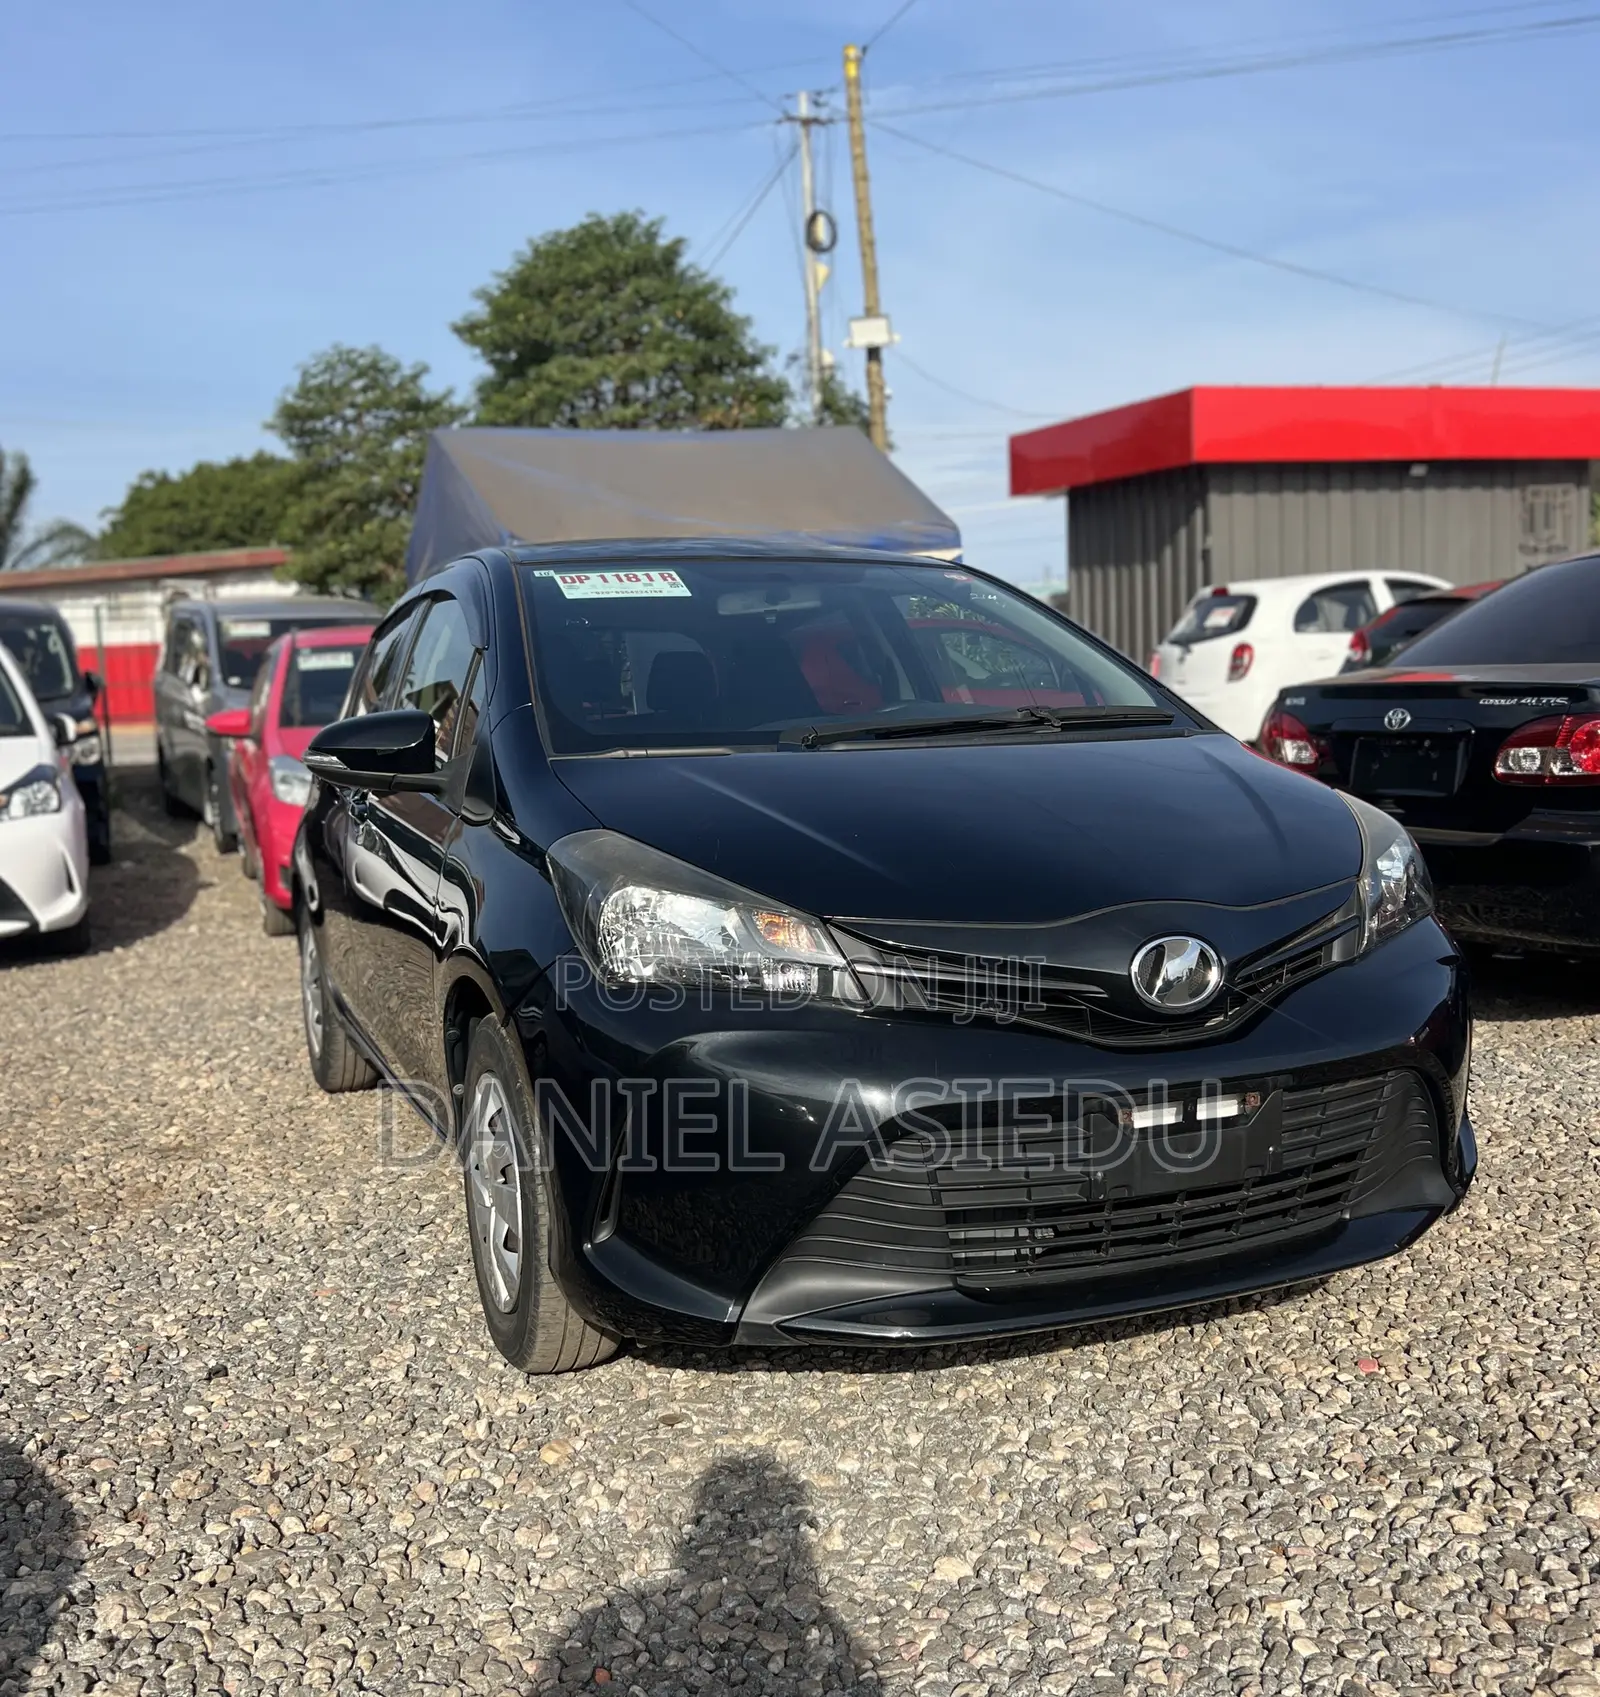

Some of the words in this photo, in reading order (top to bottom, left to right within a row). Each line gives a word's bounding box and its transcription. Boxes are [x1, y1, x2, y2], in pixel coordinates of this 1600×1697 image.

[559, 575, 591, 584] DP
[596, 573, 655, 584] 1181
[657, 572, 677, 582] R
